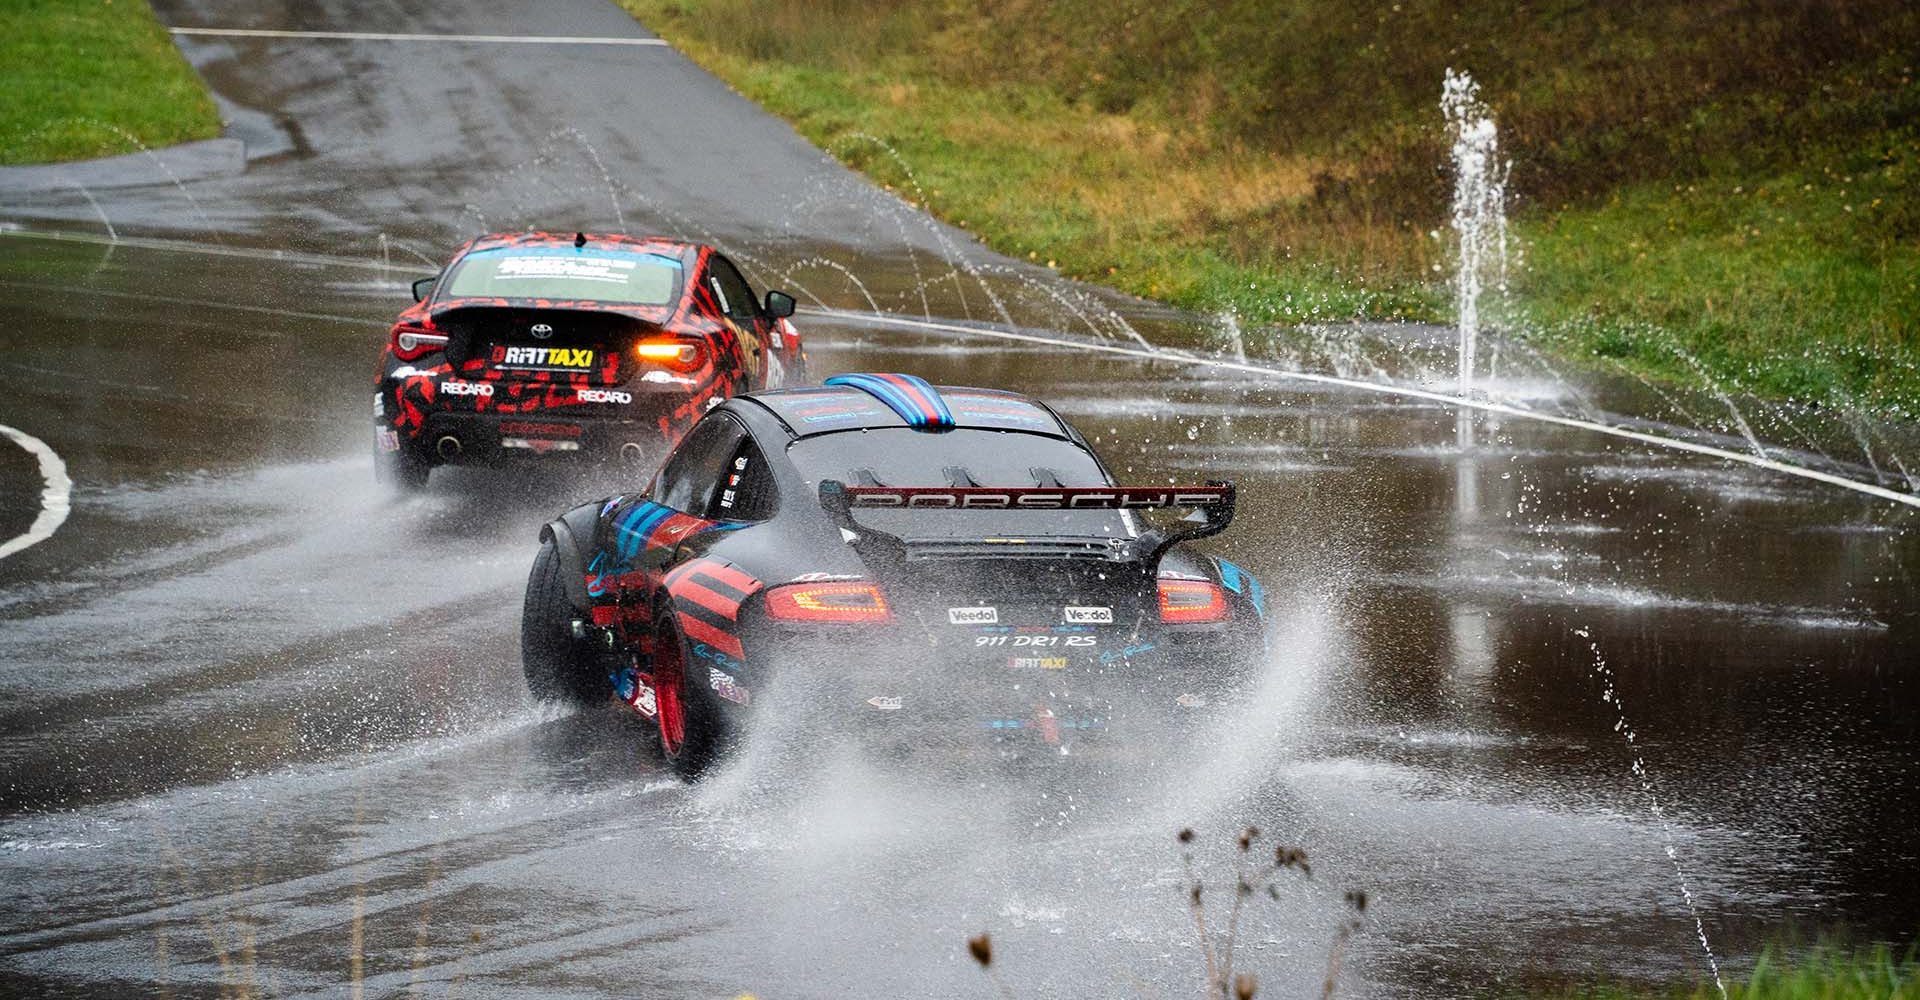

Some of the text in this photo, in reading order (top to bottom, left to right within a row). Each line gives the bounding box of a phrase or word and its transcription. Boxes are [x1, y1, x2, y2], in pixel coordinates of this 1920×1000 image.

[440, 382, 495, 397] RECARO
[577, 389, 632, 405] RECARO
[855, 494, 1221, 509] PORSCHE
[951, 610, 996, 621] Veedol
[975, 635, 1097, 647] 911 DR1 RS
